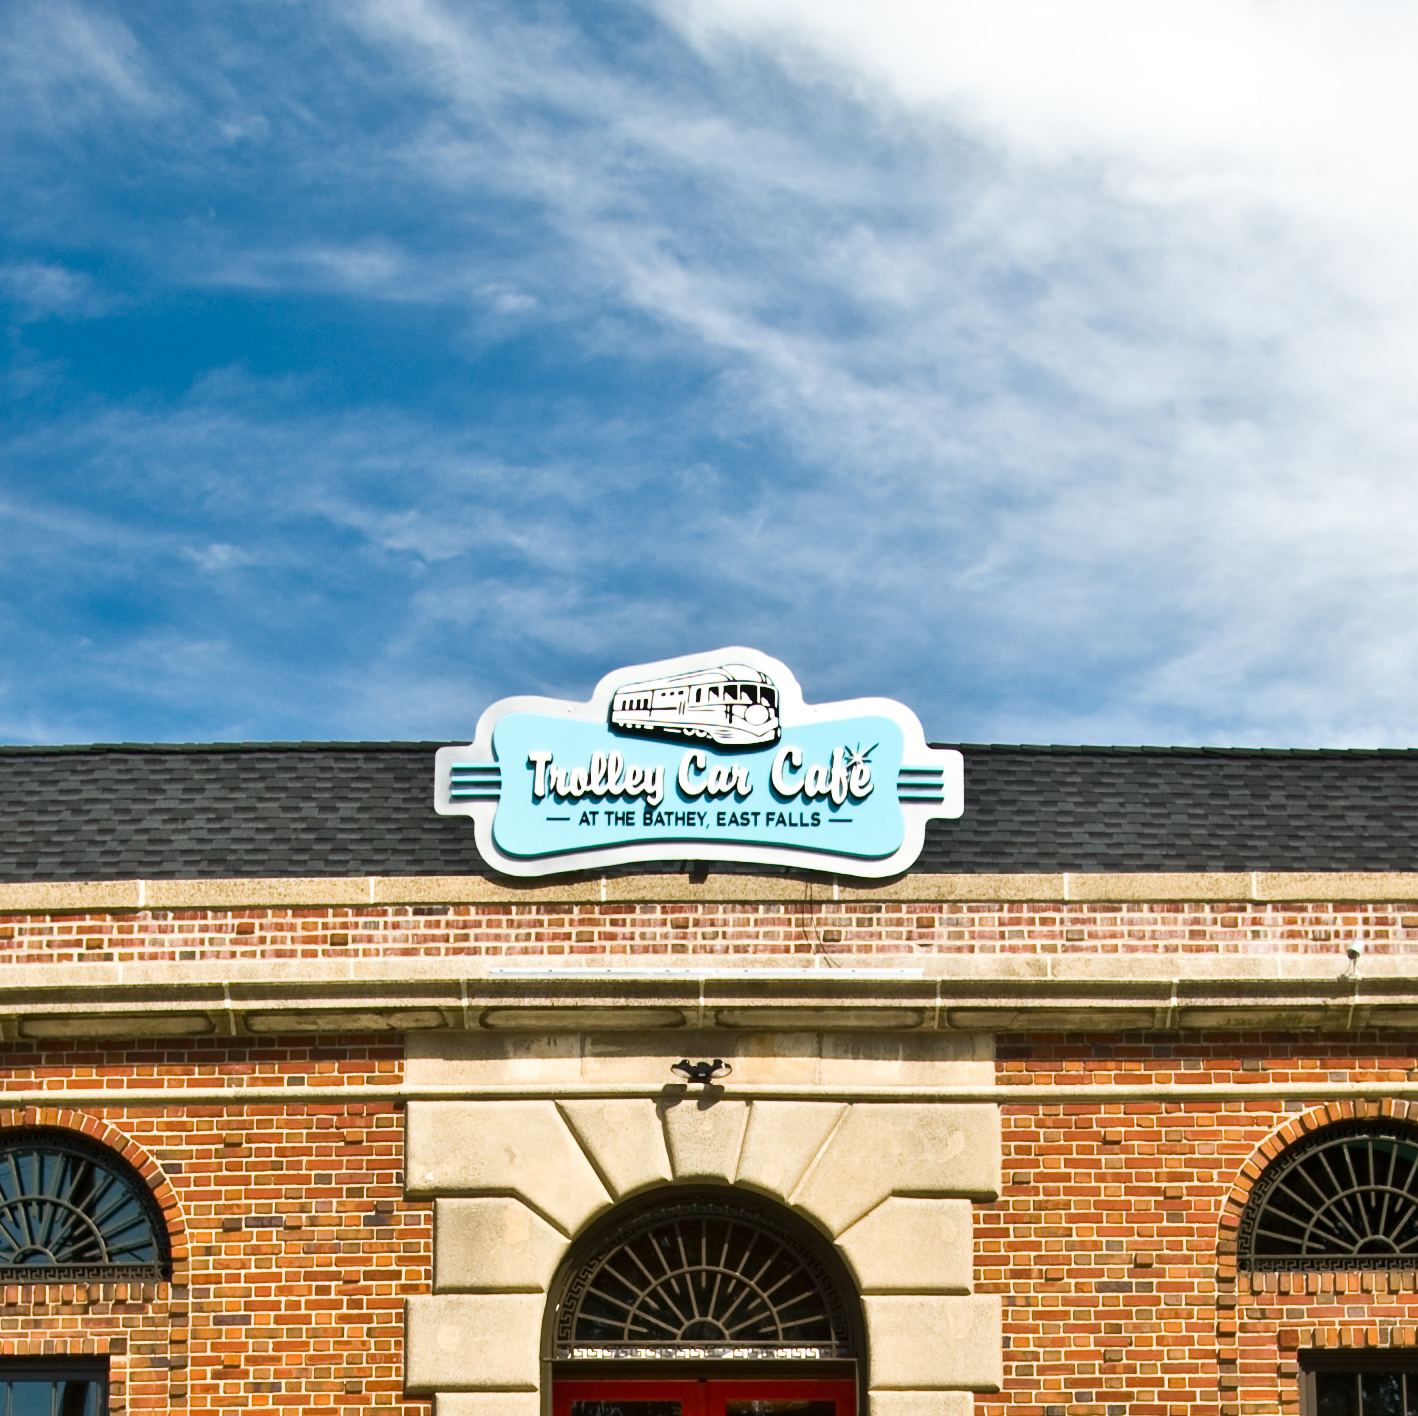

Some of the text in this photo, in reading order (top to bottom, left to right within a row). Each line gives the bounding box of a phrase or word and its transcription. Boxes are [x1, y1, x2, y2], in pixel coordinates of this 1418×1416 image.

[527, 749, 665, 807] Trolley
[677, 749, 753, 797] Car
[579, 811, 821, 830] AT THE BATHEY, EAST FALLS
